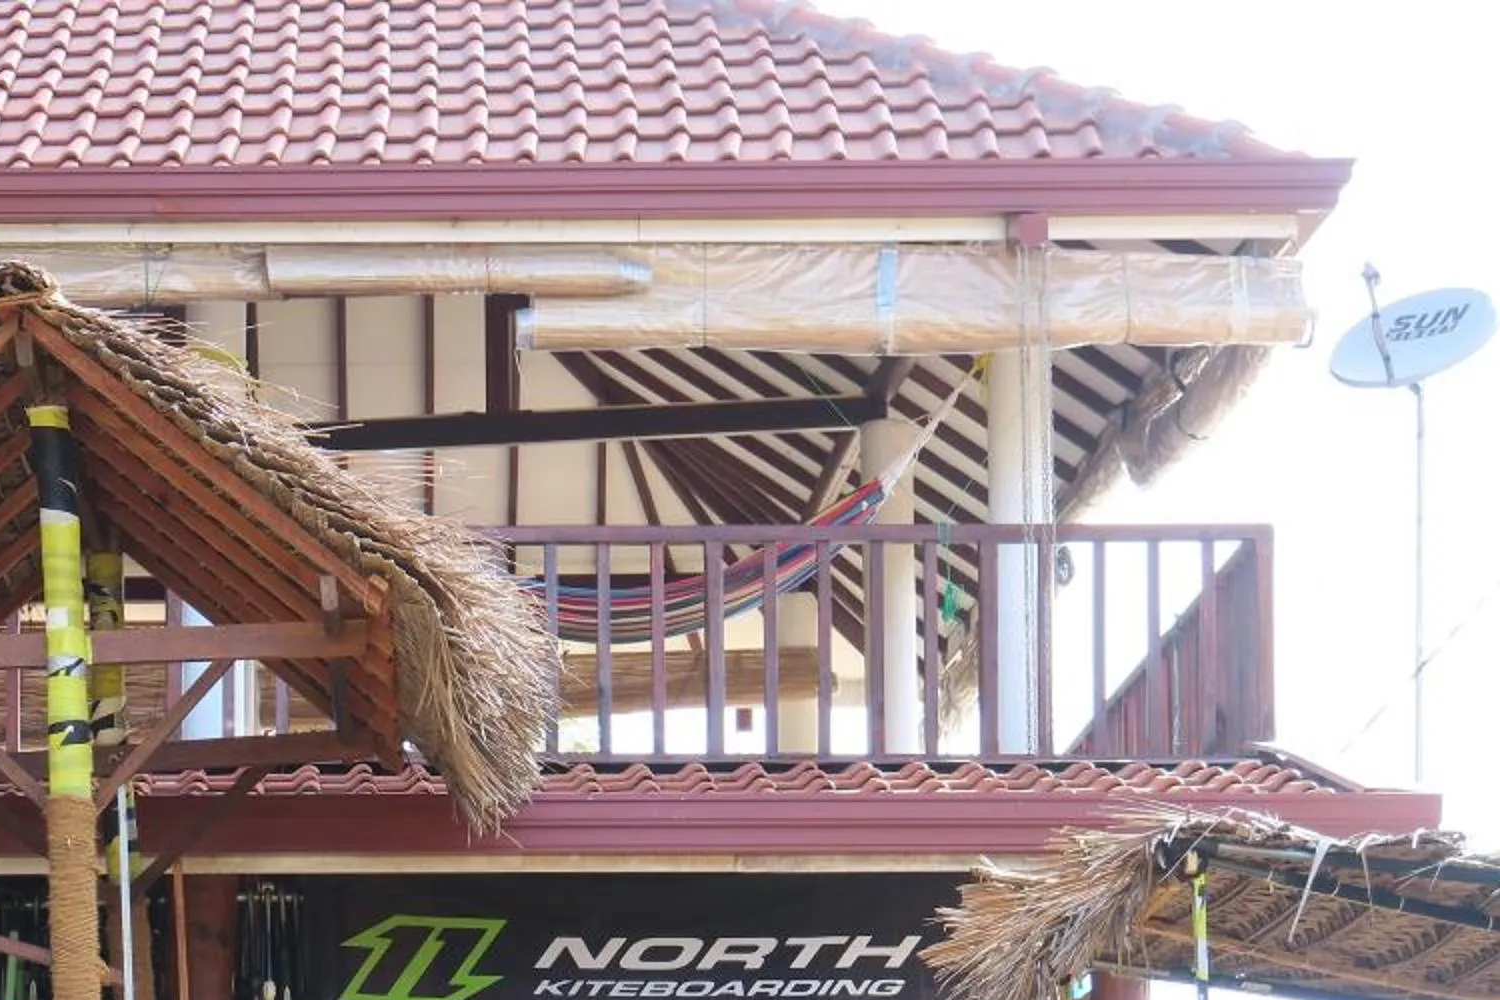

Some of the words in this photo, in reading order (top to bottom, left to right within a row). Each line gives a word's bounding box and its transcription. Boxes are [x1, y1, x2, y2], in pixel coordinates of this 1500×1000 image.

[1394, 303, 1470, 331] SUN
[534, 936, 922, 971] NORTH
[534, 979, 906, 998] KITEBOARDING
